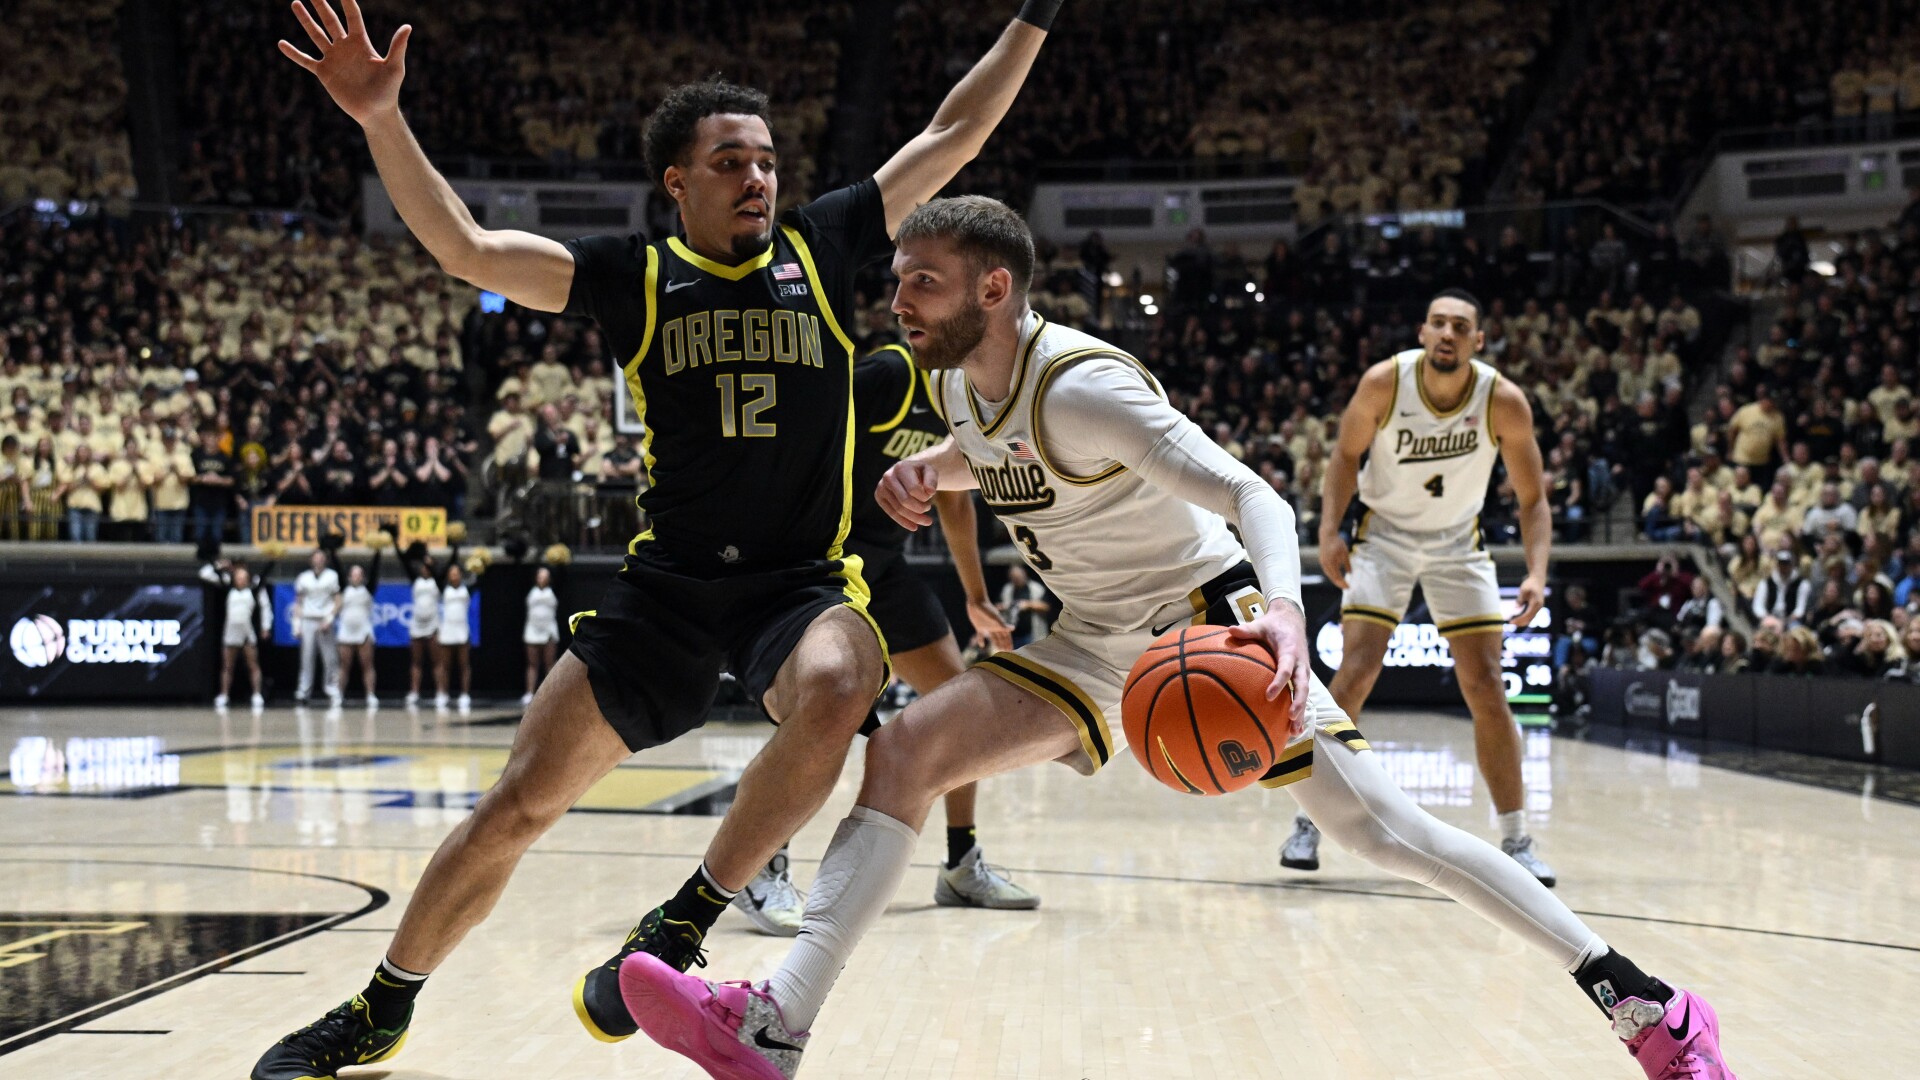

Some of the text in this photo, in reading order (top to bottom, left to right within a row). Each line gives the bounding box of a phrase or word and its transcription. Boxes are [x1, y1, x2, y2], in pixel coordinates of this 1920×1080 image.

[662, 309, 824, 376] OREGON
[716, 373, 776, 437] 12
[1395, 429, 1479, 460] Purdue
[970, 455, 1054, 510] urdue
[1424, 474, 1445, 498] 4
[257, 511, 360, 543] DEFENSE
[1014, 525, 1053, 570] 3
[68, 619, 181, 646] PURDUE
[1217, 739, 1264, 778] P
